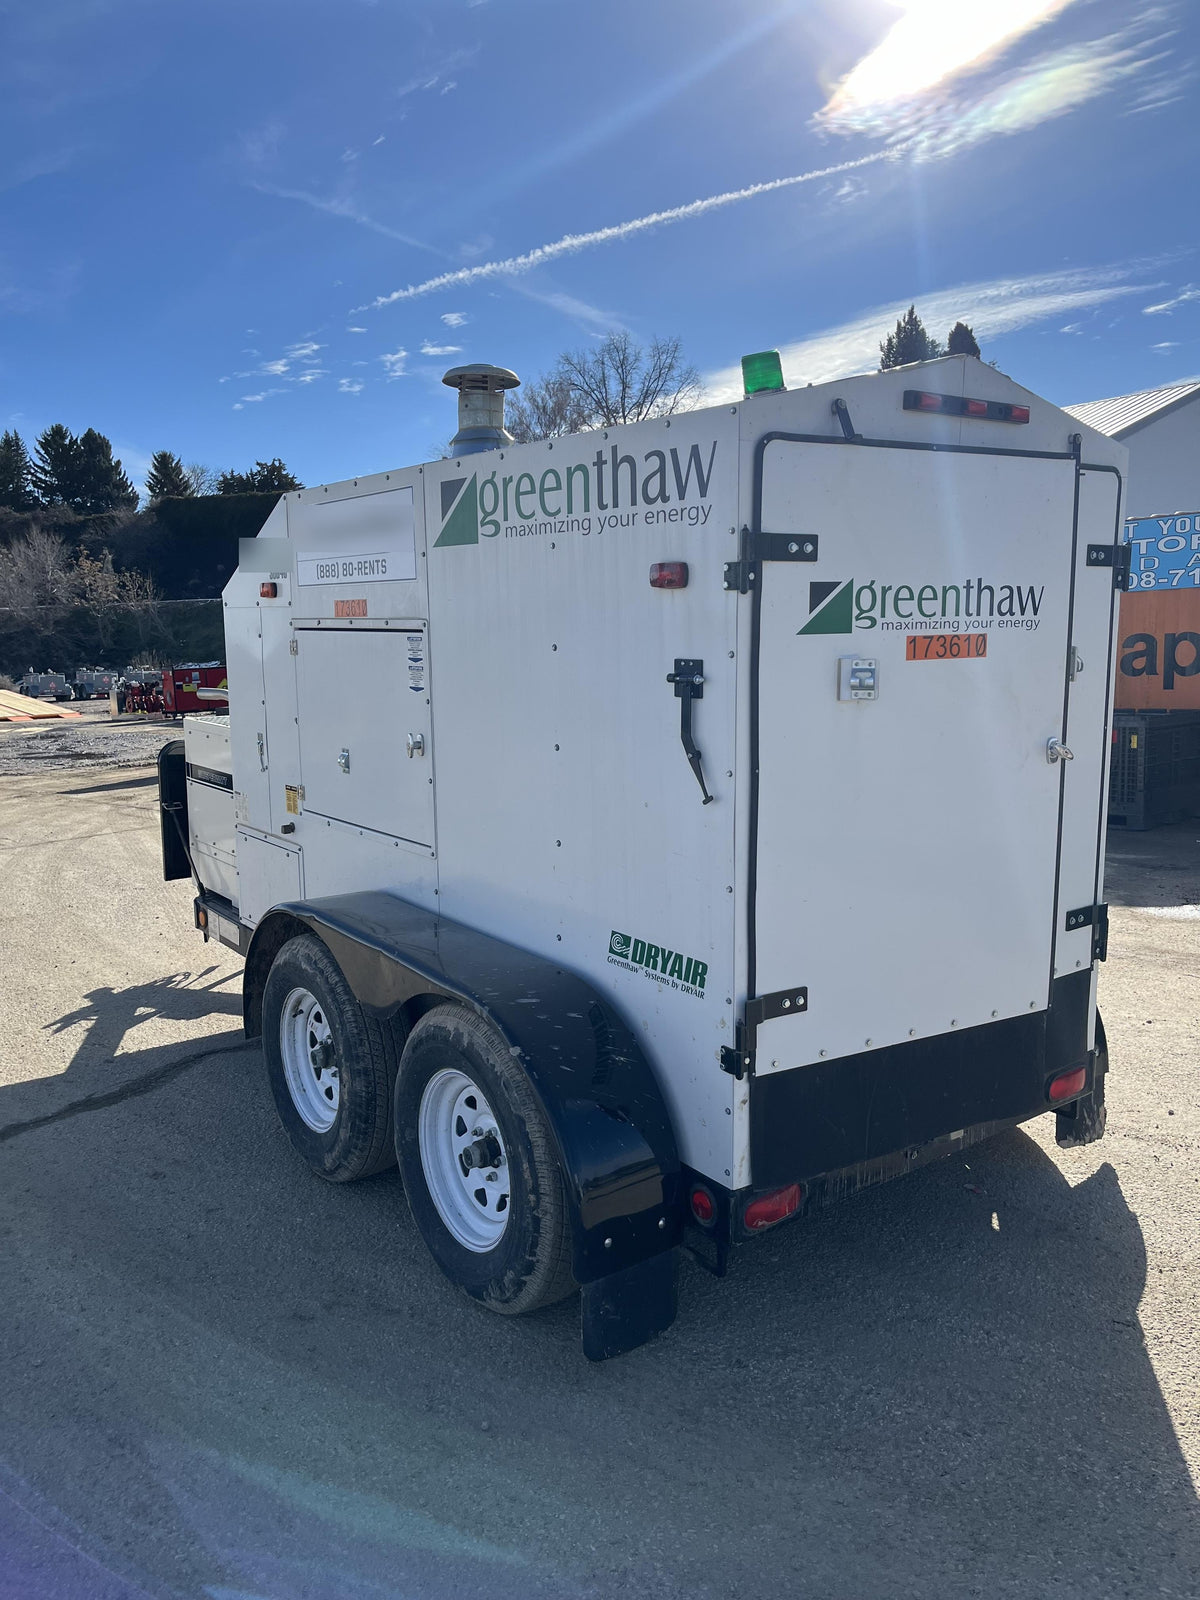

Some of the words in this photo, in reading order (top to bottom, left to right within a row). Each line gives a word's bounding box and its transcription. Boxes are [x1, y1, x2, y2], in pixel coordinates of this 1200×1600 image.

[479, 440, 718, 538] greenthaw
[505, 515, 592, 538] maximizing
[597, 512, 638, 535] your
[644, 504, 713, 526] energy
[1123, 534, 1200, 555] TO
[316, 561, 340, 580] (888)
[342, 558, 388, 577] 80-RENTS
[335, 599, 367, 617] 173610
[854, 577, 1045, 629] greenthaw
[881, 617, 960, 632] maximizing
[964, 619, 995, 632] your
[997, 617, 1041, 631] energy
[908, 633, 988, 659] 173610
[630, 938, 709, 989] DRYAIR
[644, 969, 670, 986] Systems
[671, 979, 679, 991] by
[681, 983, 705, 1000] DRYAIR
